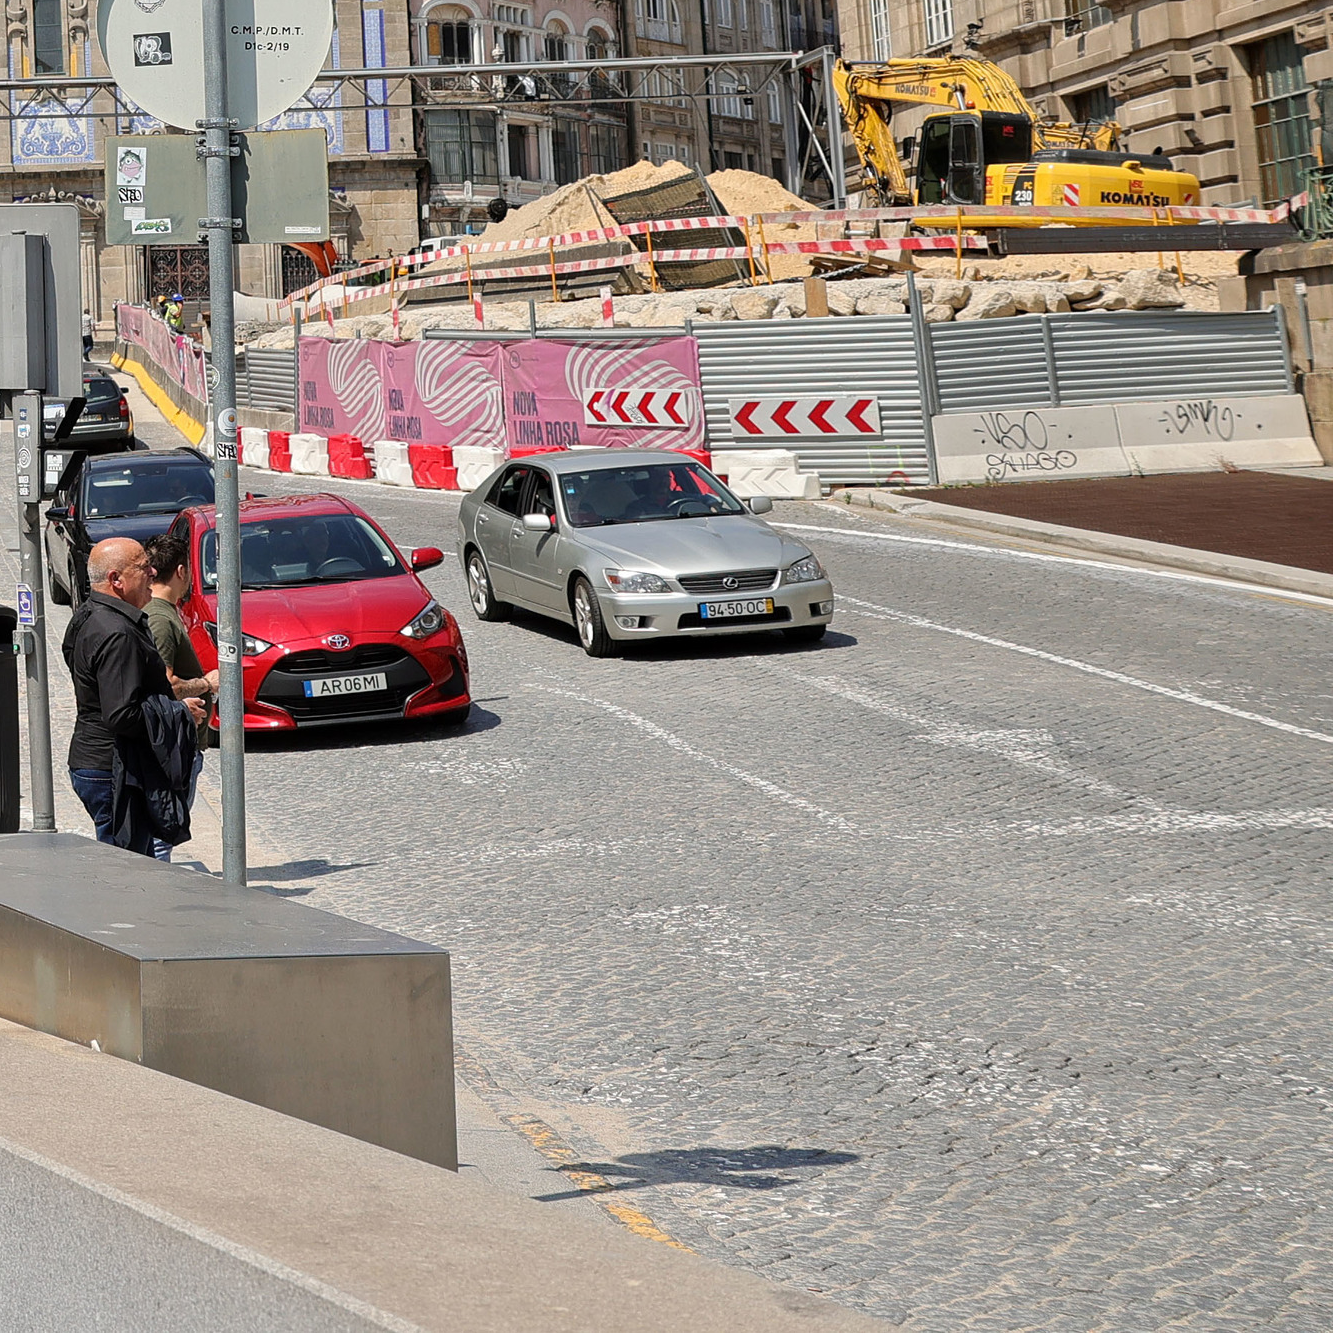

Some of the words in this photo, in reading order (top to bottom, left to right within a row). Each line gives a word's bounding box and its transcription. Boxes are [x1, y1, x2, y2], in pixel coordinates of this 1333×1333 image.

[231, 25, 304, 36] C.M.P./D.M.T.
[245, 41, 290, 53] D1c-2/19
[895, 83, 930, 96] KOMATSU
[1014, 190, 1033, 202] 230
[1100, 190, 1170, 208] KOMATSU
[304, 381, 317, 402] NOVA
[388, 389, 405, 411] NOVA
[513, 391, 538, 416] NOVA
[304, 405, 319, 427] LINHA
[513, 420, 545, 446] LINHA
[546, 421, 580, 446] ROSA
[708, 600, 766, 617] 94-50-OC
